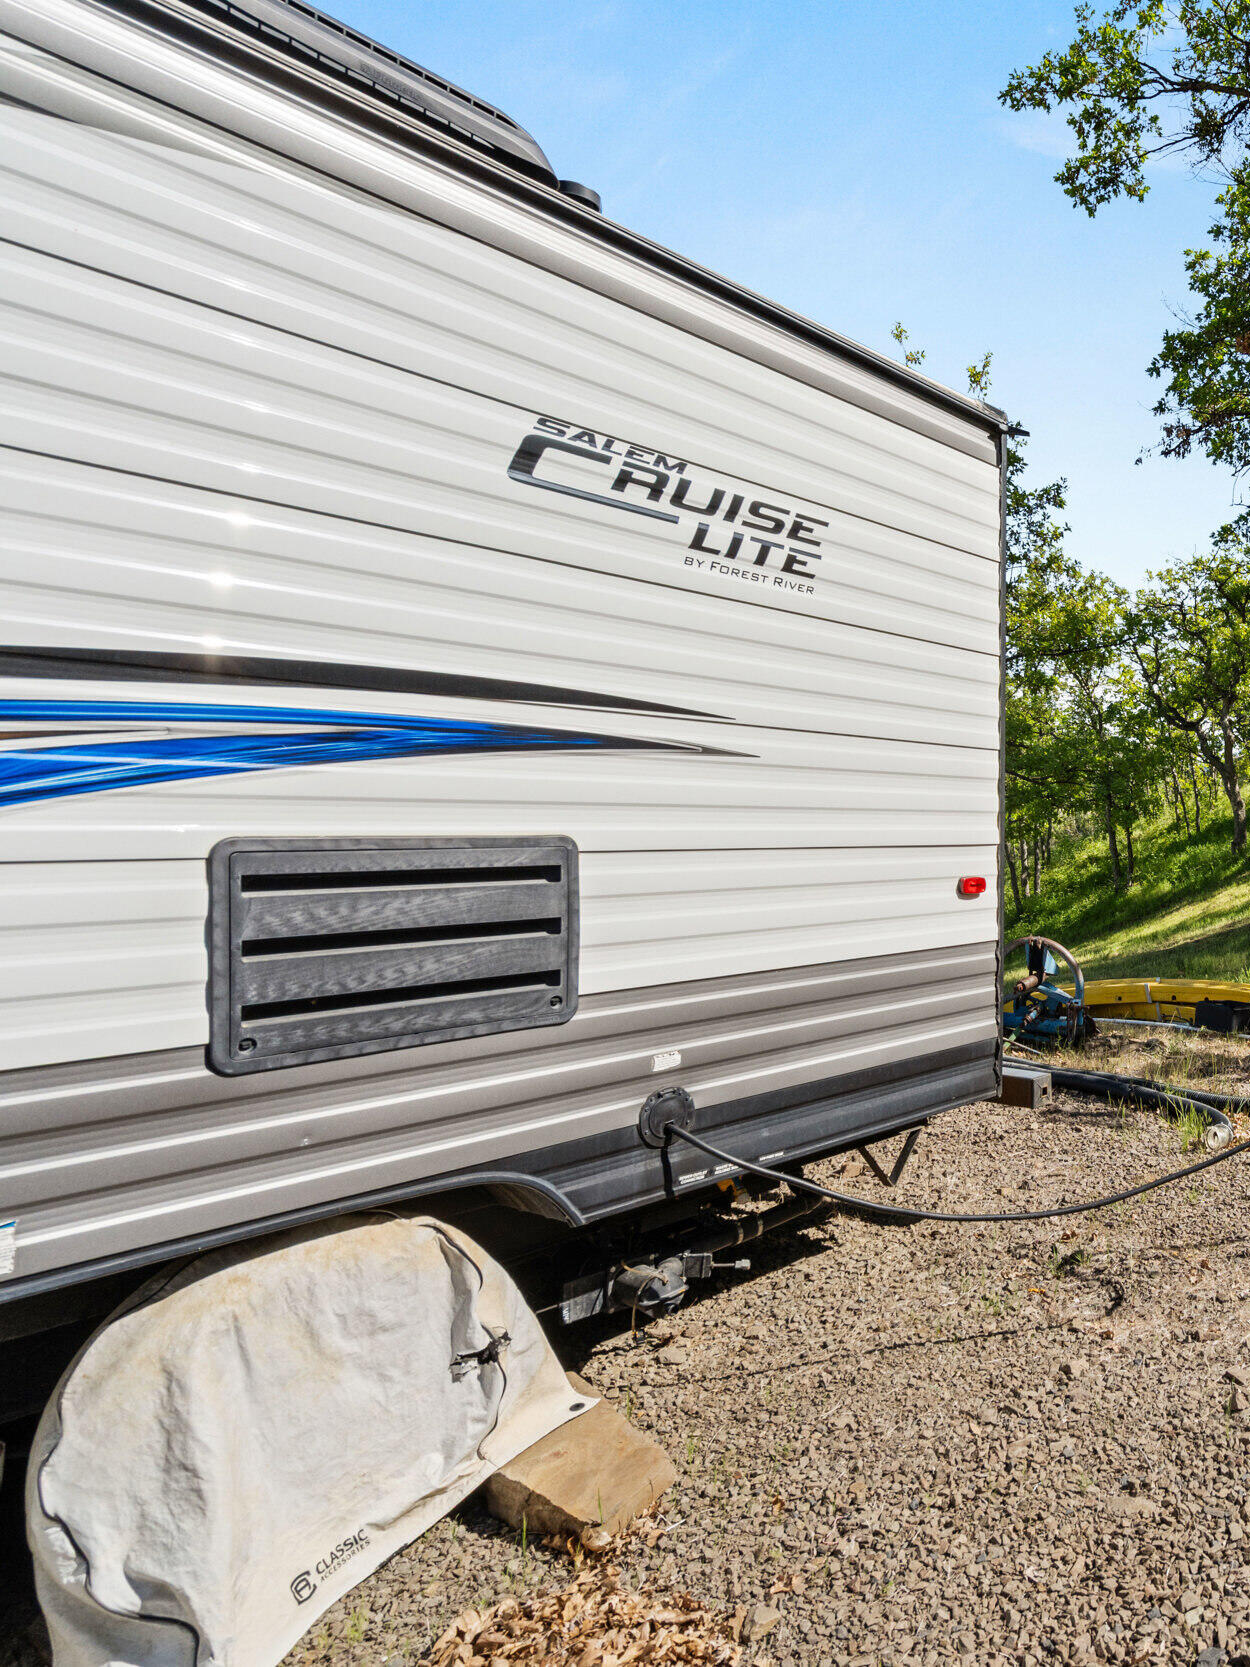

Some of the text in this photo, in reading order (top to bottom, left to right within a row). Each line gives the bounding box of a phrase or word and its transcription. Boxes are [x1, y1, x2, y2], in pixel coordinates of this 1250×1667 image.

[533, 417, 688, 475] SALEM
[507, 434, 830, 547] CRUISE
[684, 556, 815, 595] BY FOREST RIVER
[688, 522, 822, 580] LITE
[316, 1529, 369, 1574] CLASSIC
[320, 1540, 371, 1582] ACCESSORIES
